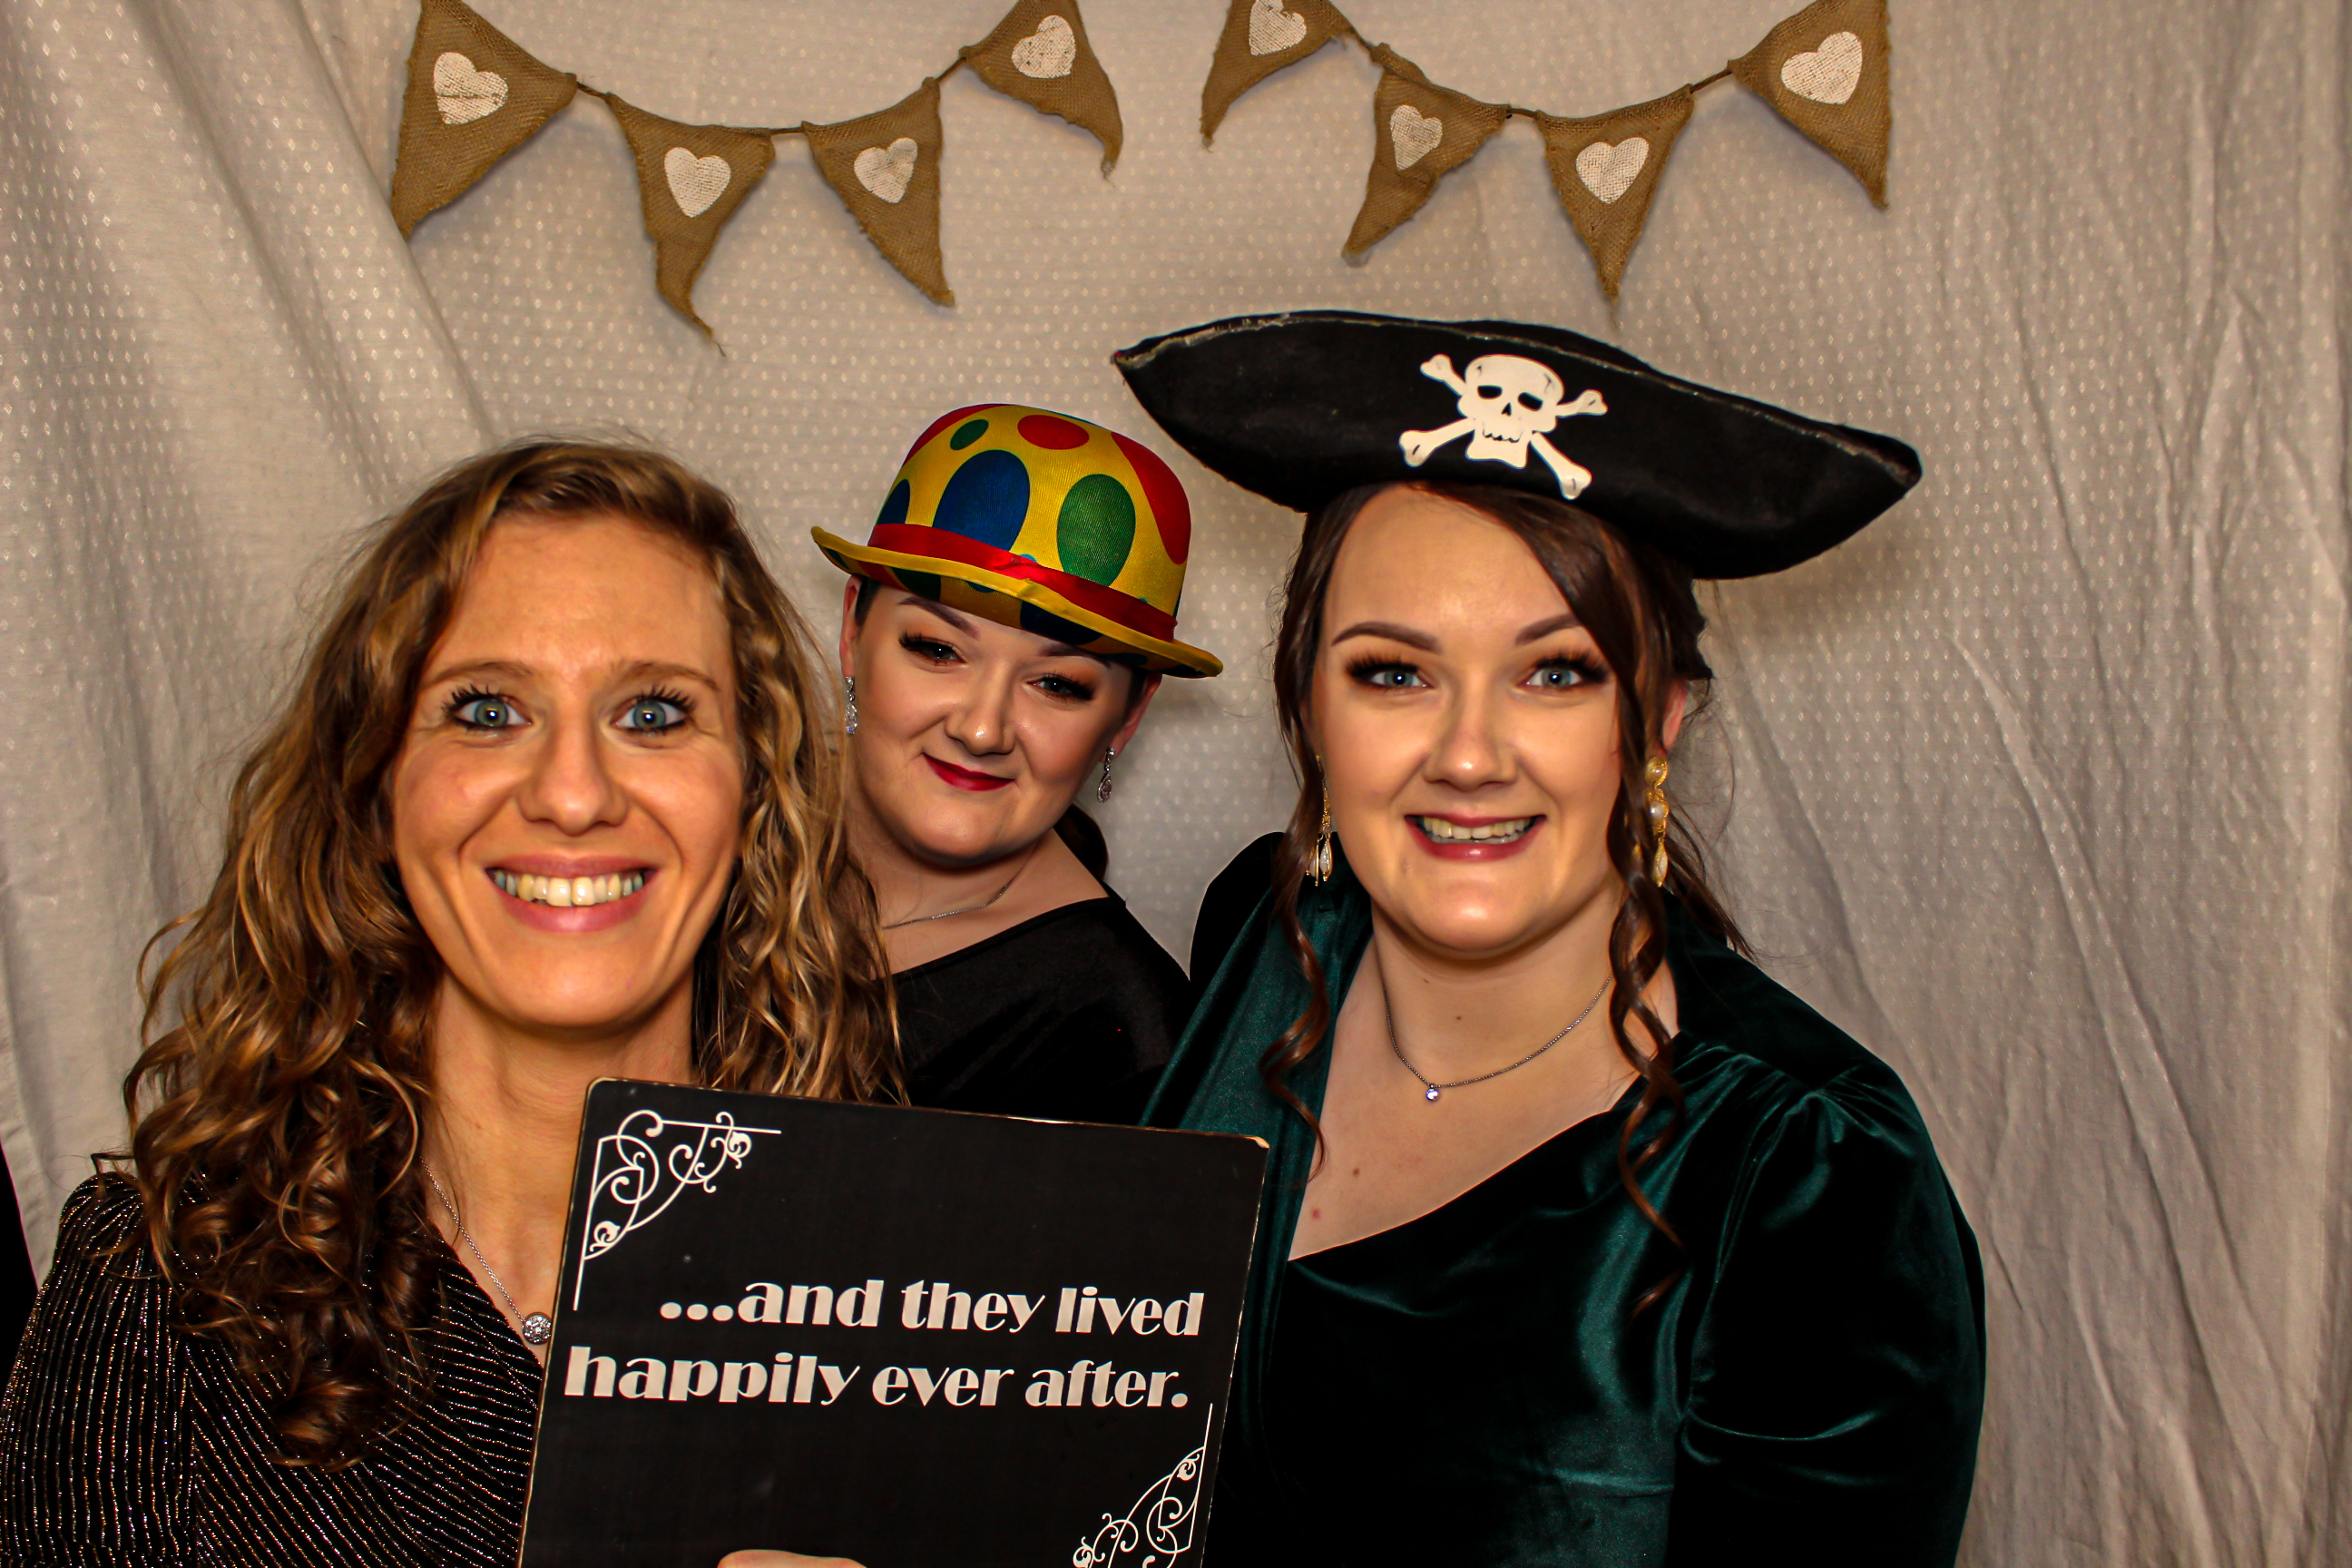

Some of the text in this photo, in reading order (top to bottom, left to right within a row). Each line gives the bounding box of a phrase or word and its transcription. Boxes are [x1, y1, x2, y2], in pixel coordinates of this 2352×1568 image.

[660, 1279, 1205, 1336] ...and they lived
[564, 1346, 1188, 1407] happily ever after.
